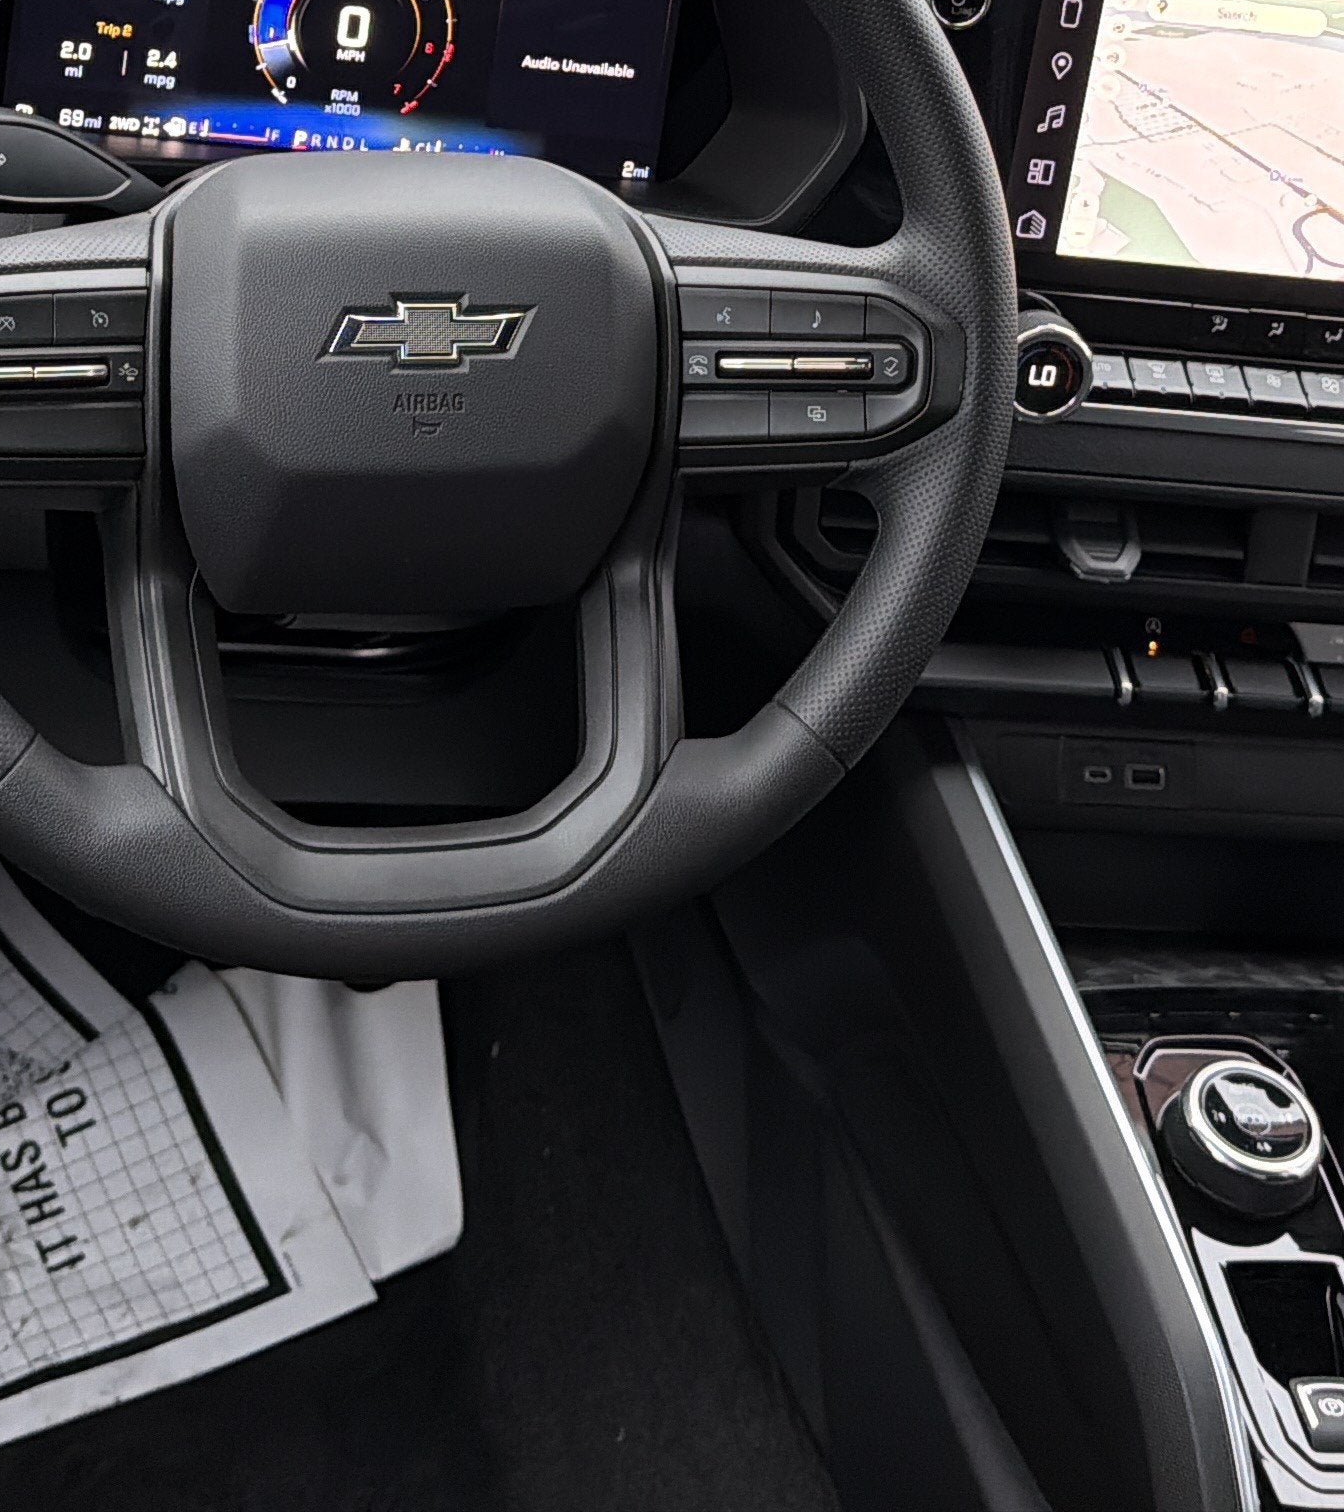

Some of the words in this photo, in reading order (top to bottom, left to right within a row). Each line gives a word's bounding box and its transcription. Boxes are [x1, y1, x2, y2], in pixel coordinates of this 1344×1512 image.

[96, 21, 120, 39] Trip
[122, 24, 134, 37] 2
[336, 4, 372, 49] 0
[60, 40, 93, 61] 2.0
[336, 48, 366, 63] MPH
[424, 42, 435, 55] 6
[146, 48, 178, 69] 2.4
[521, 54, 560, 71] Audio
[561, 58, 635, 79] Unavailable
[64, 65, 83, 78] mi
[143, 73, 176, 90] mpg
[286, 75, 297, 89] 0
[393, 83, 402, 96] 7
[330, 88, 359, 103] RPM
[324, 102, 361, 117] x1000
[109, 115, 141, 132] 2WD
[1027, 363, 1057, 387] LO
[393, 393, 465, 413] AIRBAG
[46, 1087, 97, 1149] TO
[0, 1139, 66, 1226] HAS
[35, 1235, 87, 1274] IT
